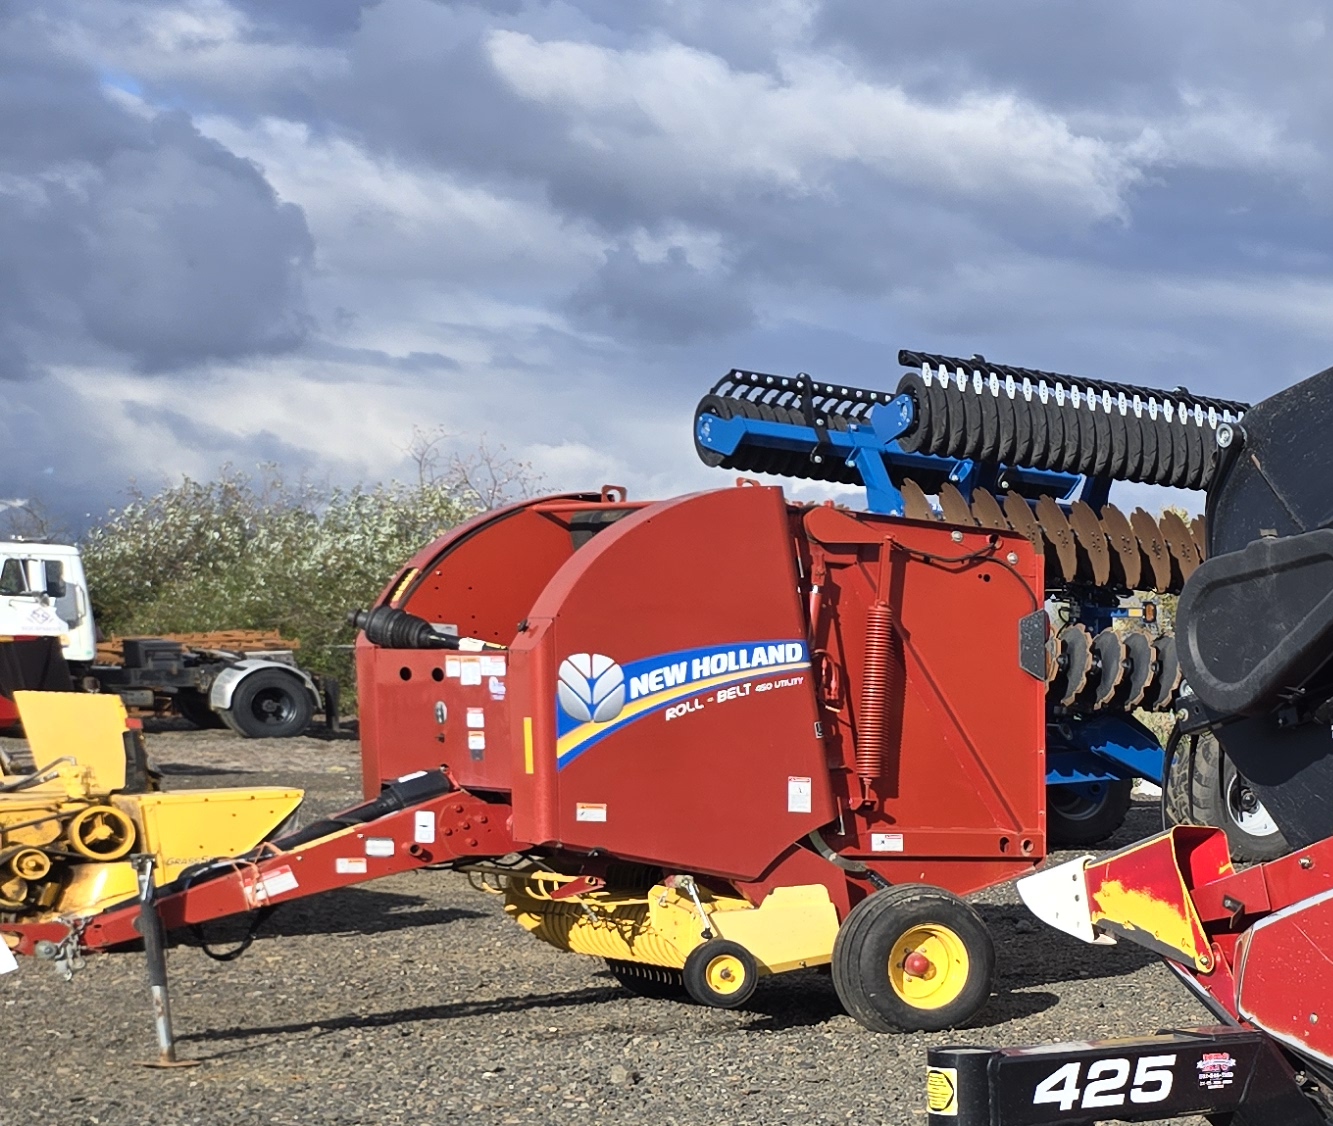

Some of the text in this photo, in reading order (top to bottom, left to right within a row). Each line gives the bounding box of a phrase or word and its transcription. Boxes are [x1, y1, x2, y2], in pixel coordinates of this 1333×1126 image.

[630, 643, 803, 700] NEW HOLLAND
[665, 698, 704, 721] ROLL
[716, 683, 751, 704] BELT
[774, 677, 804, 688] UTILITY
[1033, 1054, 1177, 1111] 425
